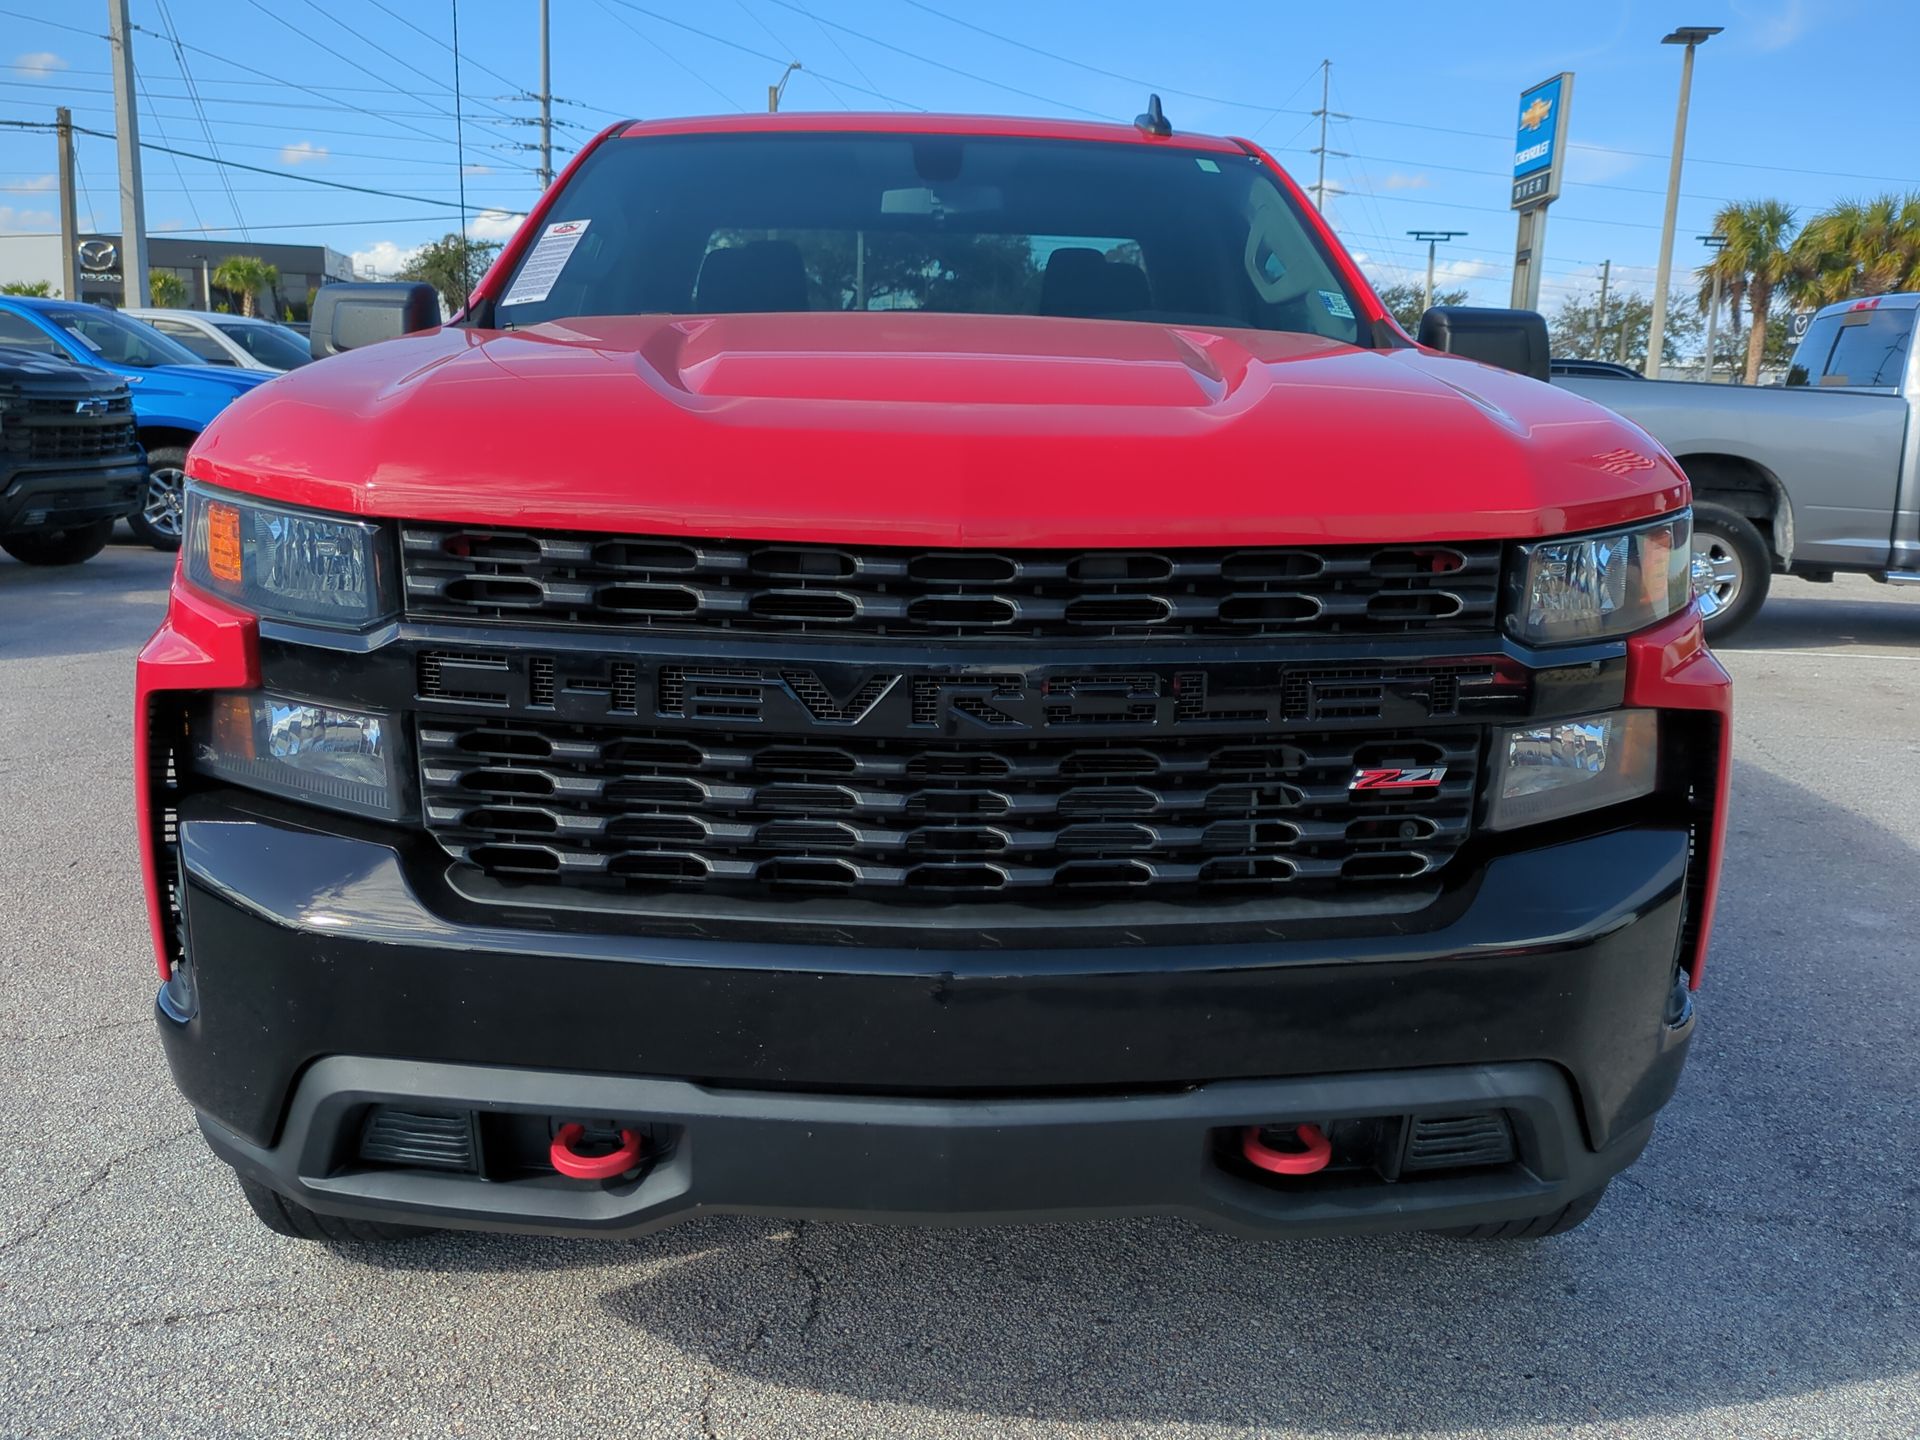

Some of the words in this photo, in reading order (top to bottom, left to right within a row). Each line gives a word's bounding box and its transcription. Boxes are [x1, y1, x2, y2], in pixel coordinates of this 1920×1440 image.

[1515, 179, 1542, 200] DYER
[414, 649, 1496, 728] CHEVROLET
[1349, 767, 1448, 790] Z71
